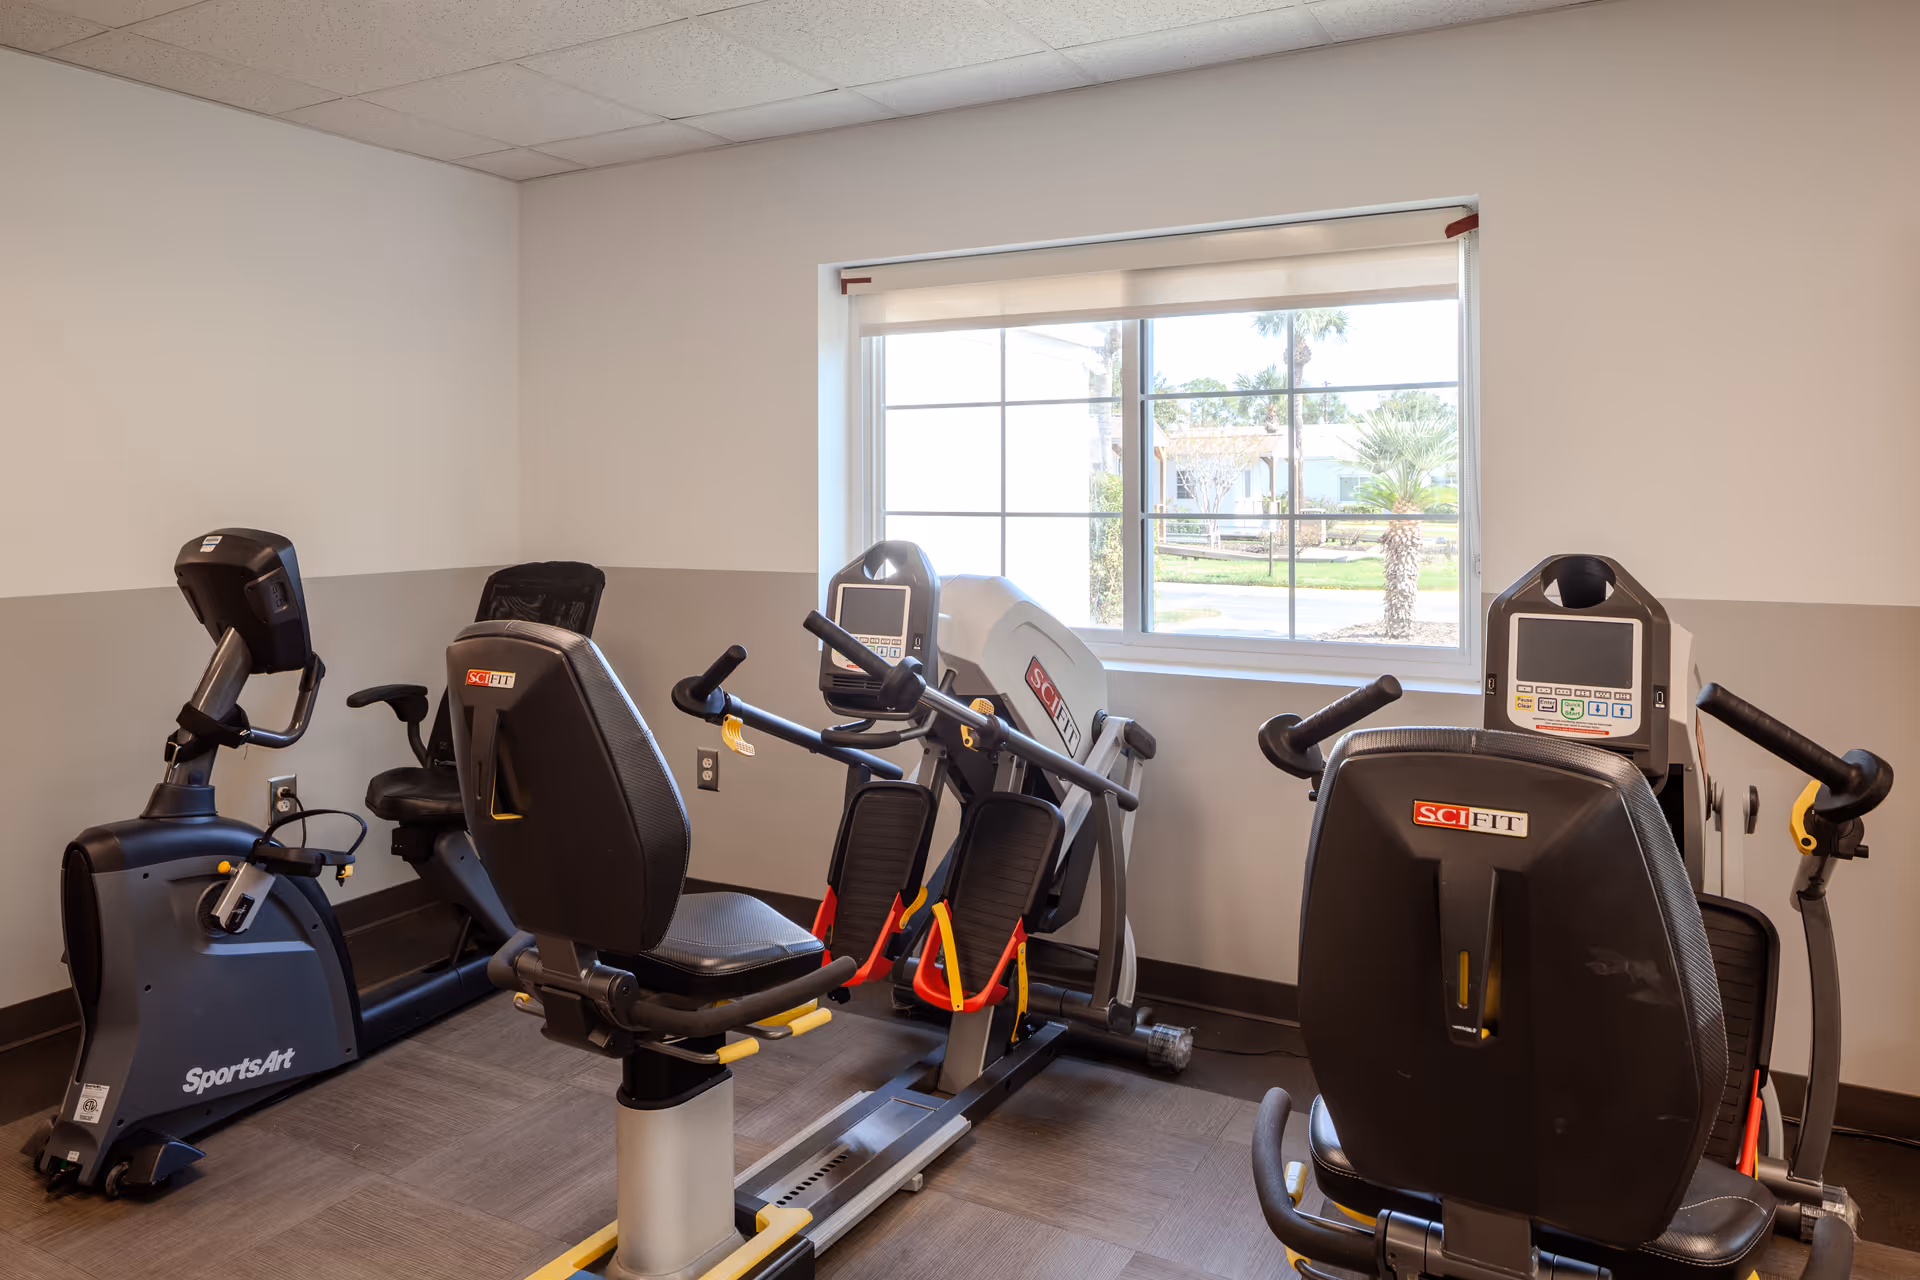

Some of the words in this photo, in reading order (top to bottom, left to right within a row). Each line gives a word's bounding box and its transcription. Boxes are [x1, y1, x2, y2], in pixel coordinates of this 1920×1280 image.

[468, 672, 513, 685] SCIFIT
[1031, 668, 1077, 745] SCIFIT
[1417, 806, 1522, 831] SCIFIT
[182, 1048, 296, 1095] SportsArt
